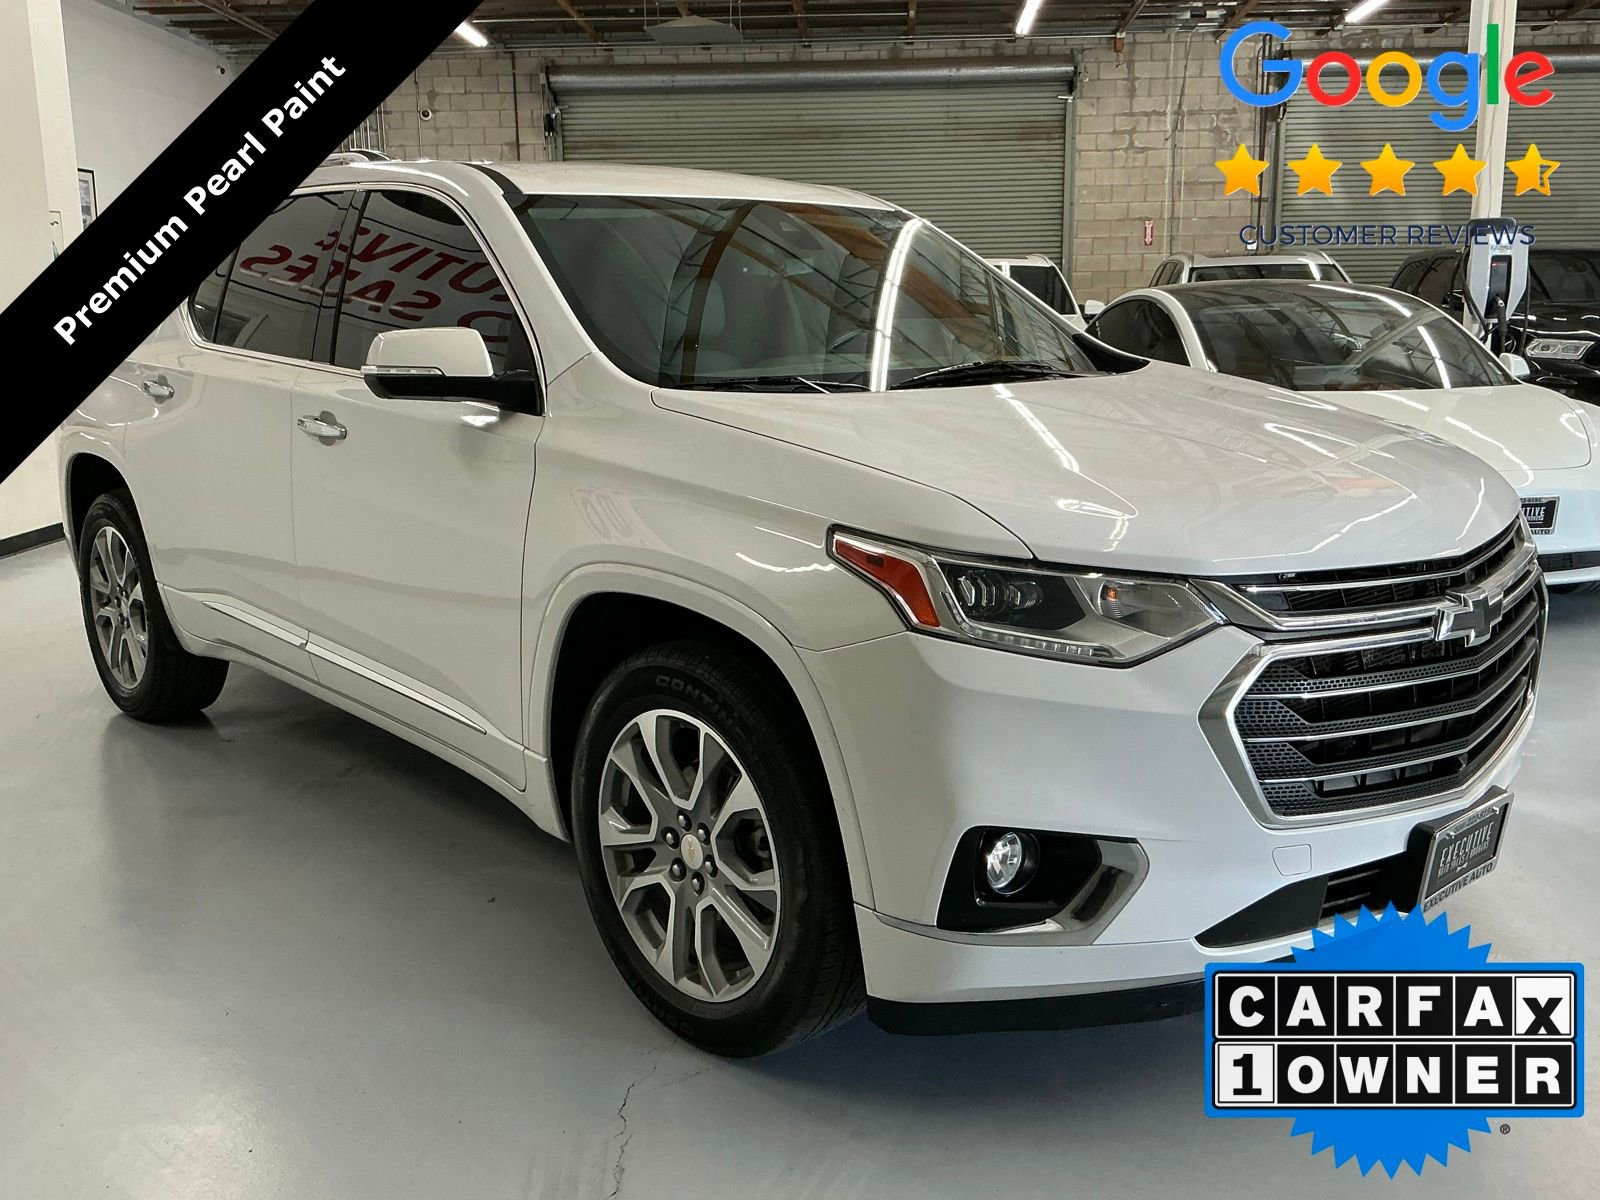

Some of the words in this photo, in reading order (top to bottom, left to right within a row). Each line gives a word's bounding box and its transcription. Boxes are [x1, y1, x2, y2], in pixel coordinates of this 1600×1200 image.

[1439, 821, 1495, 868] EXECUTIVE
[1423, 875, 1470, 911] EXECUTIVE
[1467, 862, 1493, 883] AUTO
